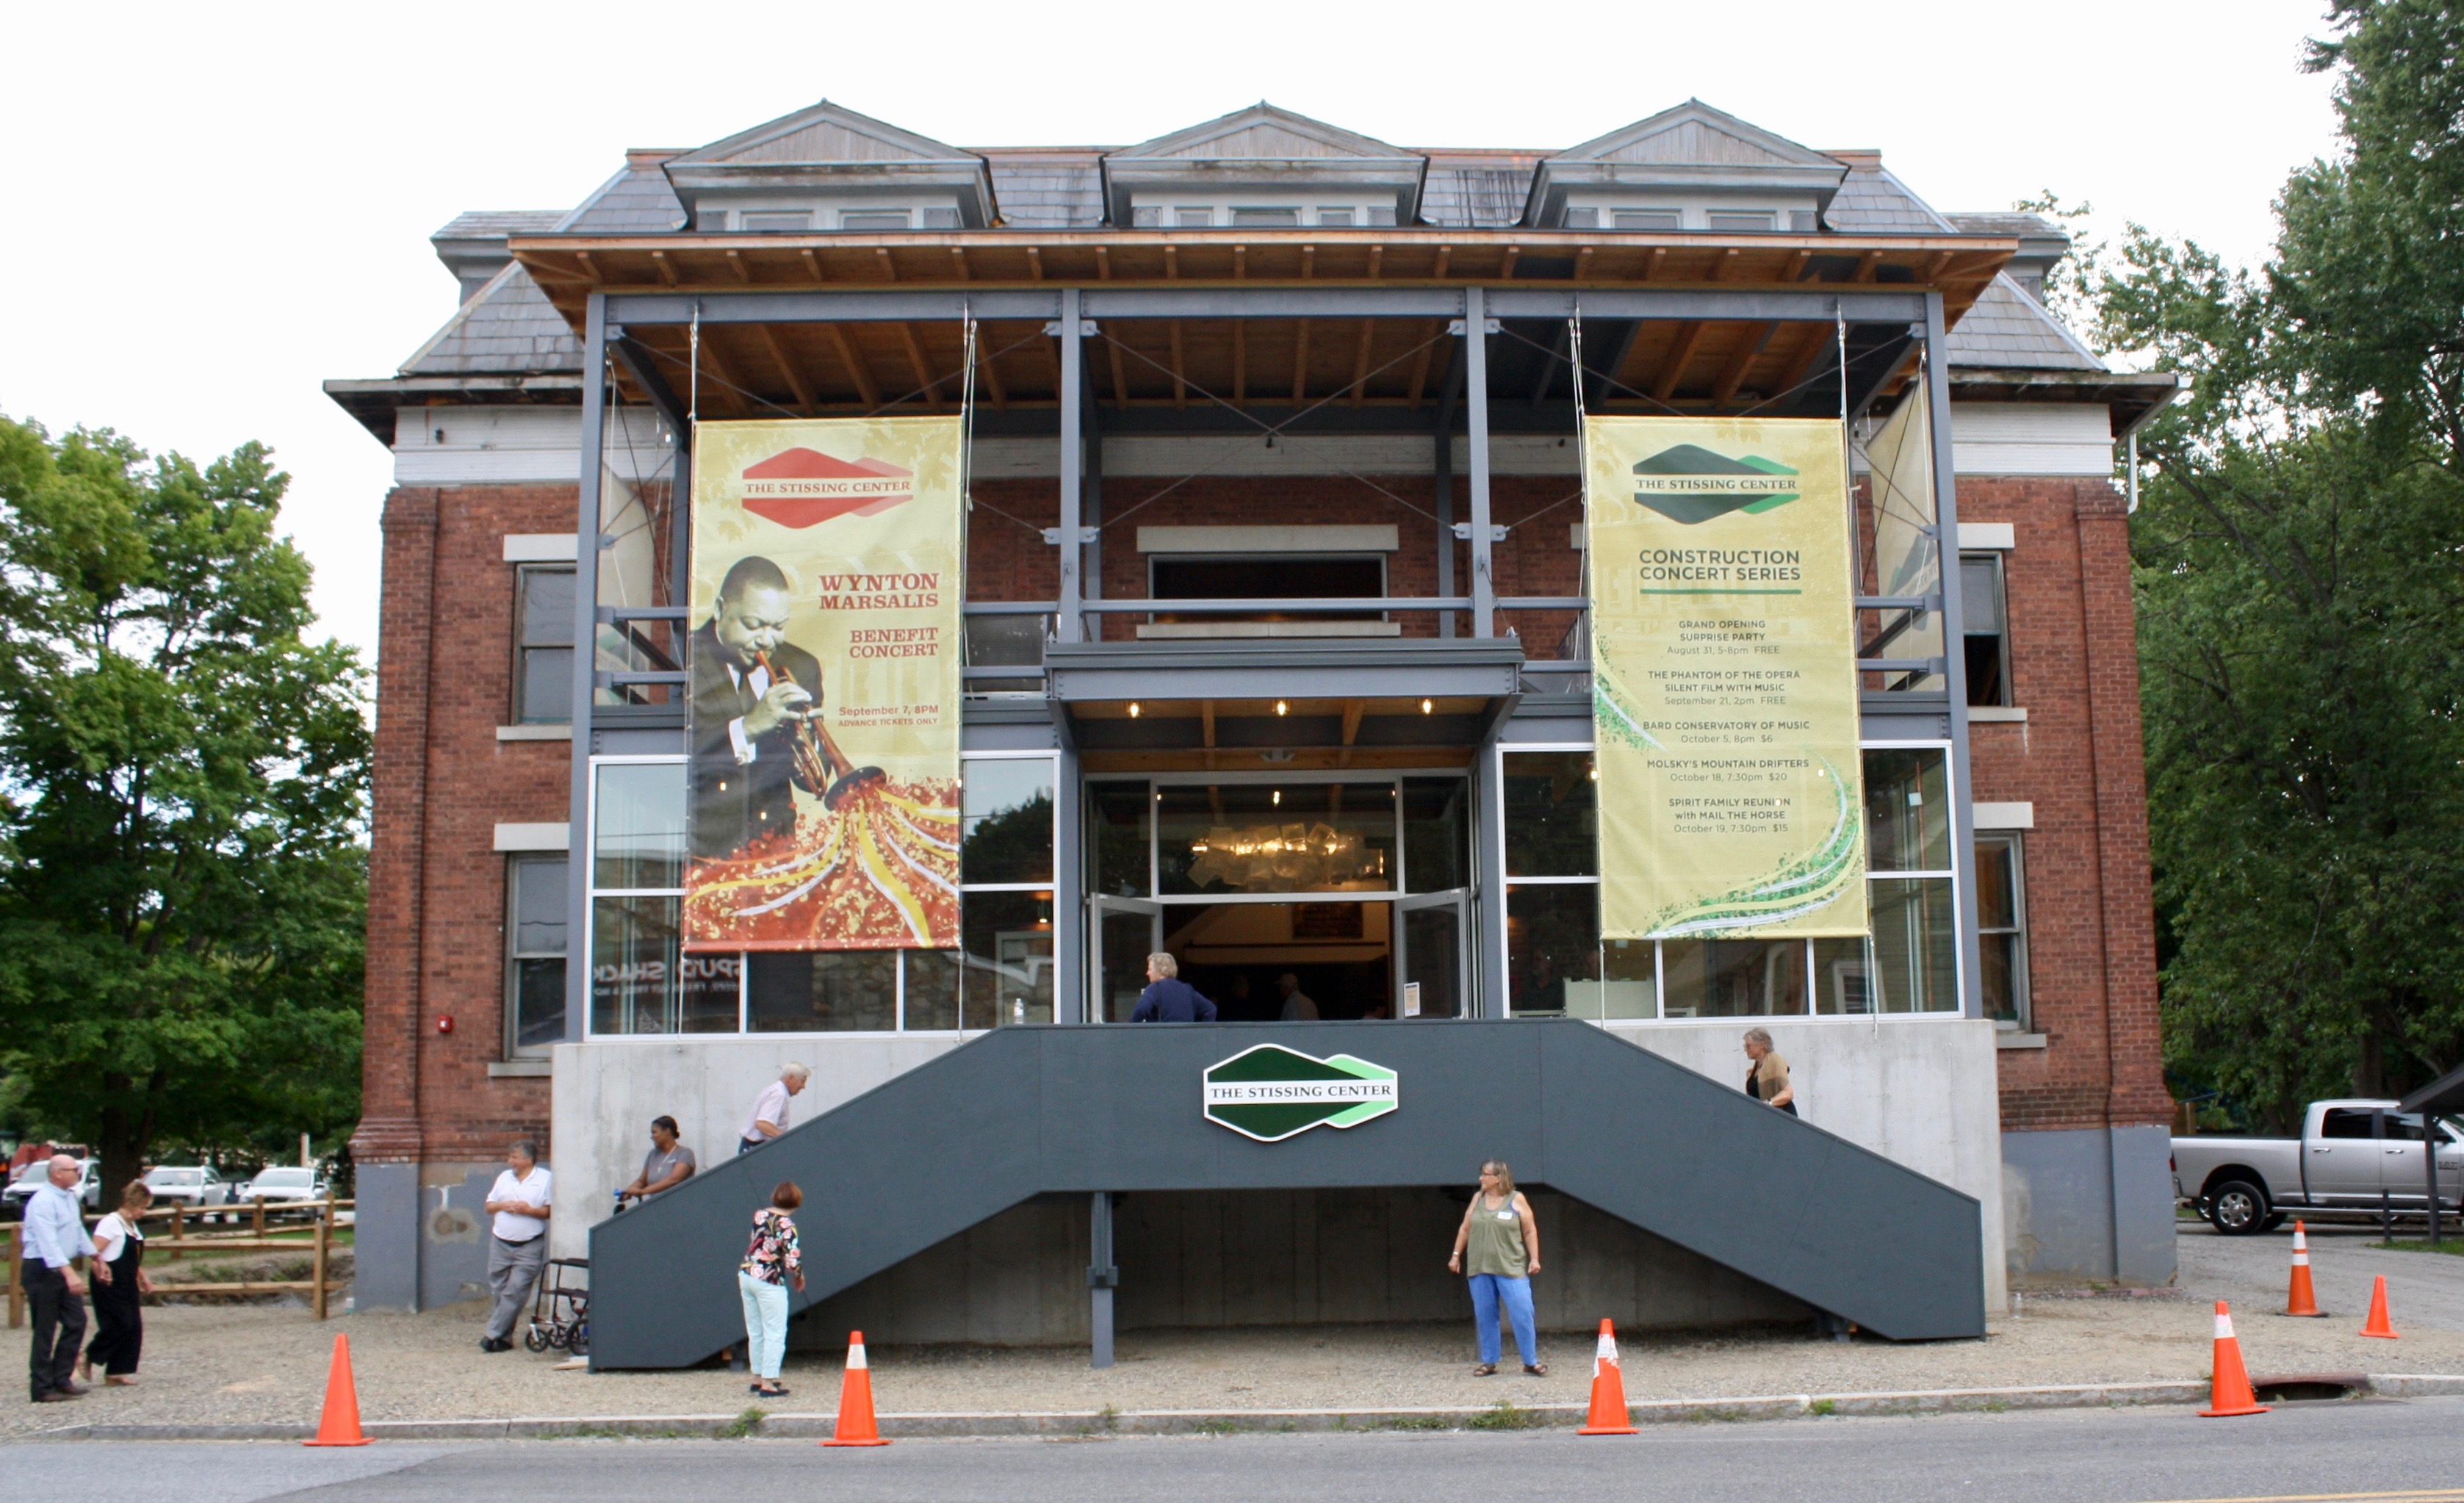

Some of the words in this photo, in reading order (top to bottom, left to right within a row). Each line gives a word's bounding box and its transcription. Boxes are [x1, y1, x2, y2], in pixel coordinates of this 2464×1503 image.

[745, 483, 775, 493] THE
[779, 483, 848, 493] STISSING
[852, 481, 910, 491] CENTER
[1636, 479, 1665, 489] THE
[1669, 480, 1735, 489] STISSING
[1740, 480, 1796, 489] CENTER
[1640, 549, 1800, 564] CONSTRUCTION
[1640, 566, 1730, 580] CONCERT
[1737, 567, 1801, 580] SERIES
[819, 573, 939, 591] WYNTON
[819, 593, 938, 610] MARSALIS
[1679, 620, 1715, 630] GRAND
[1719, 620, 1765, 629] OPENING
[849, 627, 938, 643] BENEFIT
[1679, 633, 1729, 641] SURPRISE
[1732, 632, 1765, 641] PARTY
[849, 644, 938, 658] CONCERT
[1667, 646, 1699, 656] August
[1703, 646, 1715, 655] 31,
[1718, 646, 1748, 656] 5-8pm
[1754, 646, 1779, 655] FREE
[1648, 671, 1668, 680] THE
[1671, 671, 1722, 680] PHANTOM
[1725, 671, 1739, 680] OF
[1743, 671, 1762, 680] THE
[1765, 671, 1800, 679] OPERA
[1665, 683, 1698, 692] SILENT
[1701, 683, 1723, 692] FILM
[1726, 683, 1751, 692] WITH
[1754, 683, 1784, 692] MUSIC
[1665, 696, 1716, 707] September
[1720, 696, 1732, 706] 21,
[1734, 696, 1754, 707] 2pm
[1761, 696, 1786, 704] FREE
[839, 707, 898, 717] September
[903, 705, 911, 715] 7,
[915, 705, 938, 714] 8PM
[838, 719, 877, 727] ADVANCE
[1643, 721, 1671, 730] BARD
[1675, 721, 1757, 730] CONSERVATORY
[1761, 721, 1774, 729] OF
[1778, 721, 1809, 729] MUSIC
[1681, 735, 1720, 743] October
[1723, 735, 1732, 744] 5,
[1734, 735, 1755, 745] 8pm
[1761, 735, 1773, 743] $6
[1647, 760, 1698, 768] MOLSKY'S
[1701, 760, 1756, 768] MOUNTAIN
[1759, 760, 1809, 768] DRIFTERS
[1670, 773, 1709, 782] October
[1712, 773, 1724, 782] 18,
[1727, 773, 1763, 782] 7:30pm
[1769, 772, 1787, 781] $20
[1669, 799, 1701, 807] SPIRIT
[1704, 799, 1740, 807] FAMILY
[1743, 798, 1791, 807] REUNION
[1675, 811, 1696, 820] with
[1699, 811, 1725, 819] MAIL
[1728, 811, 1747, 819] THE
[1751, 811, 1786, 819] HORSE
[1674, 824, 1712, 833] October
[1716, 824, 1727, 833] 19,
[1731, 824, 1767, 834] 7:30pm
[1773, 823, 1788, 832] $15
[1211, 1087, 1243, 1098] THE
[1249, 1086, 1322, 1097] STISSING
[1328, 1085, 1391, 1096] CENTER
